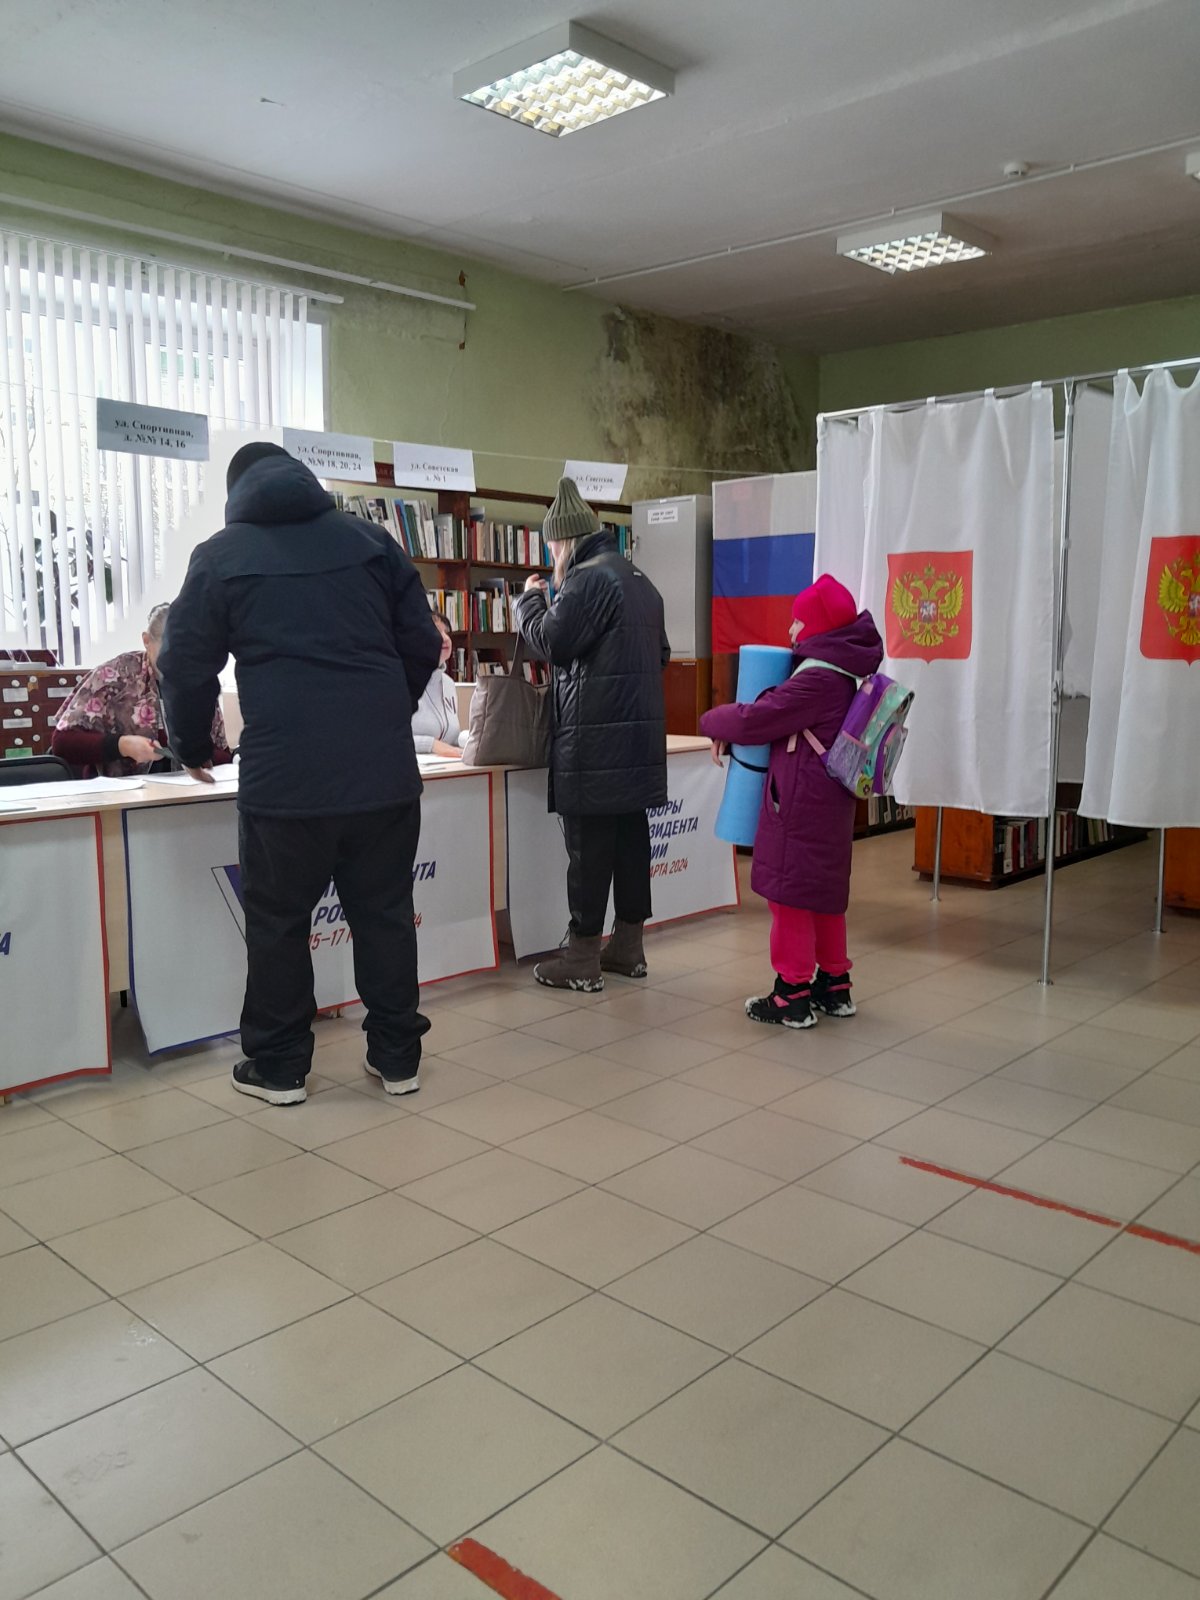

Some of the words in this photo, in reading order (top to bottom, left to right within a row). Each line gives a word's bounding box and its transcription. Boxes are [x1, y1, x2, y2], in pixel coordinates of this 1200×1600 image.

[115, 420, 130, 429] ул.
[132, 420, 194, 438] Спортивная,
[160, 437, 173, 448] 14,
[176, 439, 186, 448] 16
[311, 446, 361, 460] Спортивная,
[327, 459, 338, 469] 18,
[340, 460, 351, 471] 20,
[353, 462, 361, 471] 24
[649, 816, 699, 839] ЗИДЕНТА
[669, 857, 689, 874] 2024
